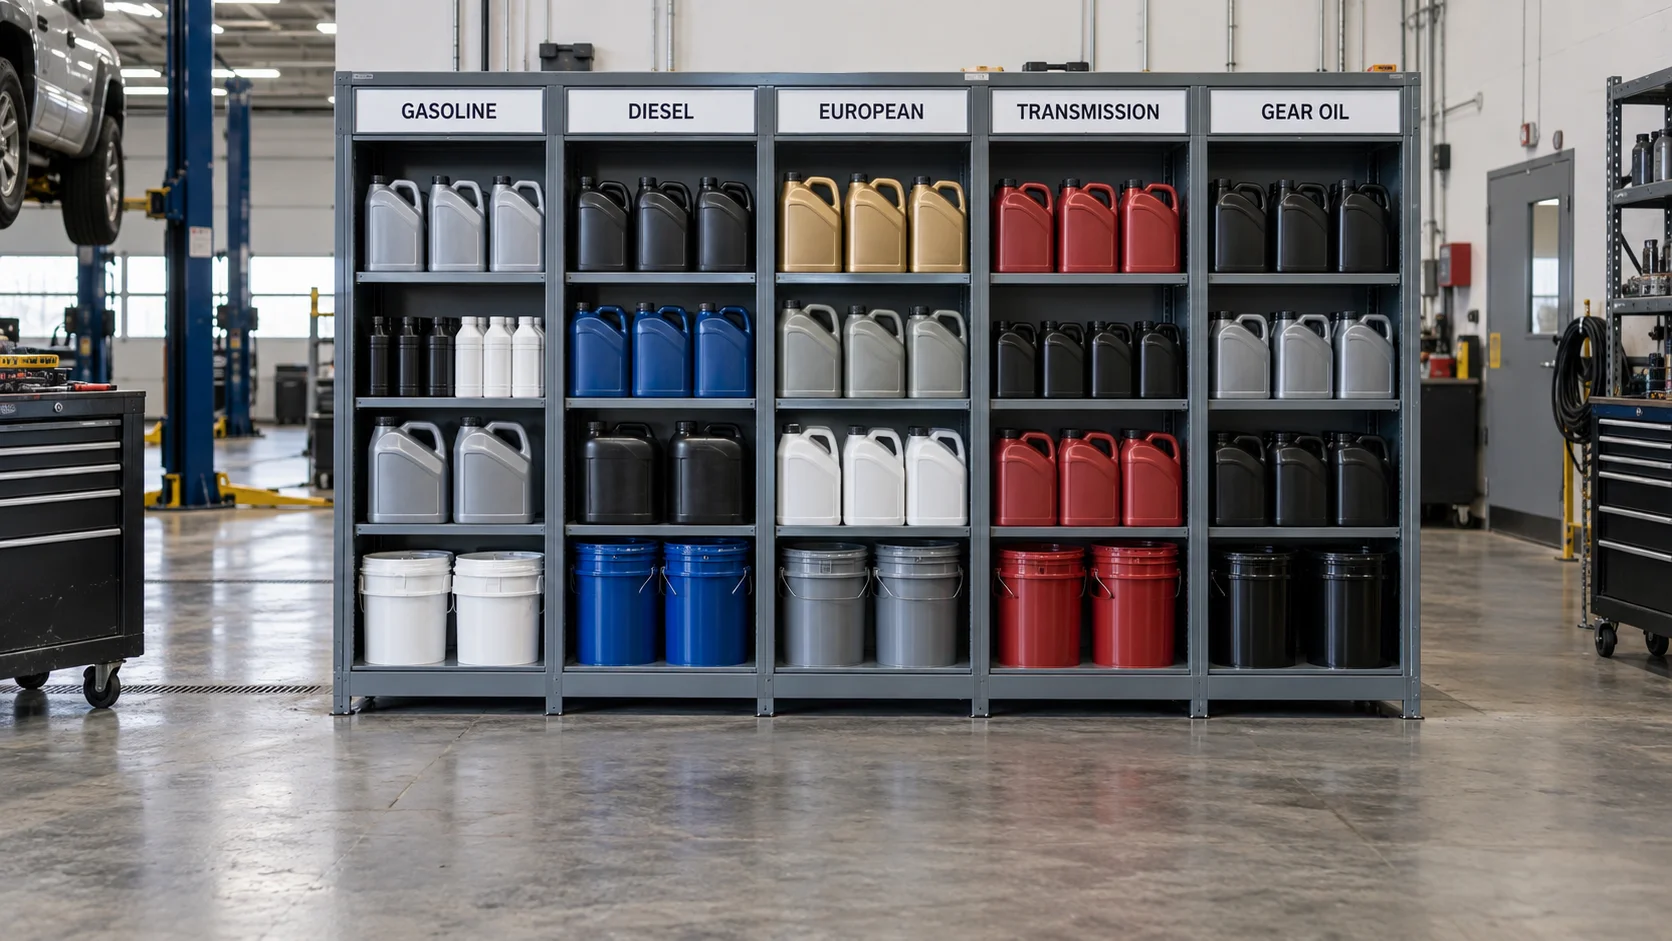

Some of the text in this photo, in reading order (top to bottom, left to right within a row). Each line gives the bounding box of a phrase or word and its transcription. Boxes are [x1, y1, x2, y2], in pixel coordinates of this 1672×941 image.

[401, 102, 497, 120] GASOLINE
[628, 102, 695, 120] DIESEL
[819, 102, 924, 120] EUROPEAN
[1016, 103, 1160, 120] TRANSMISSION
[1261, 103, 1350, 121] GEAR OIL
